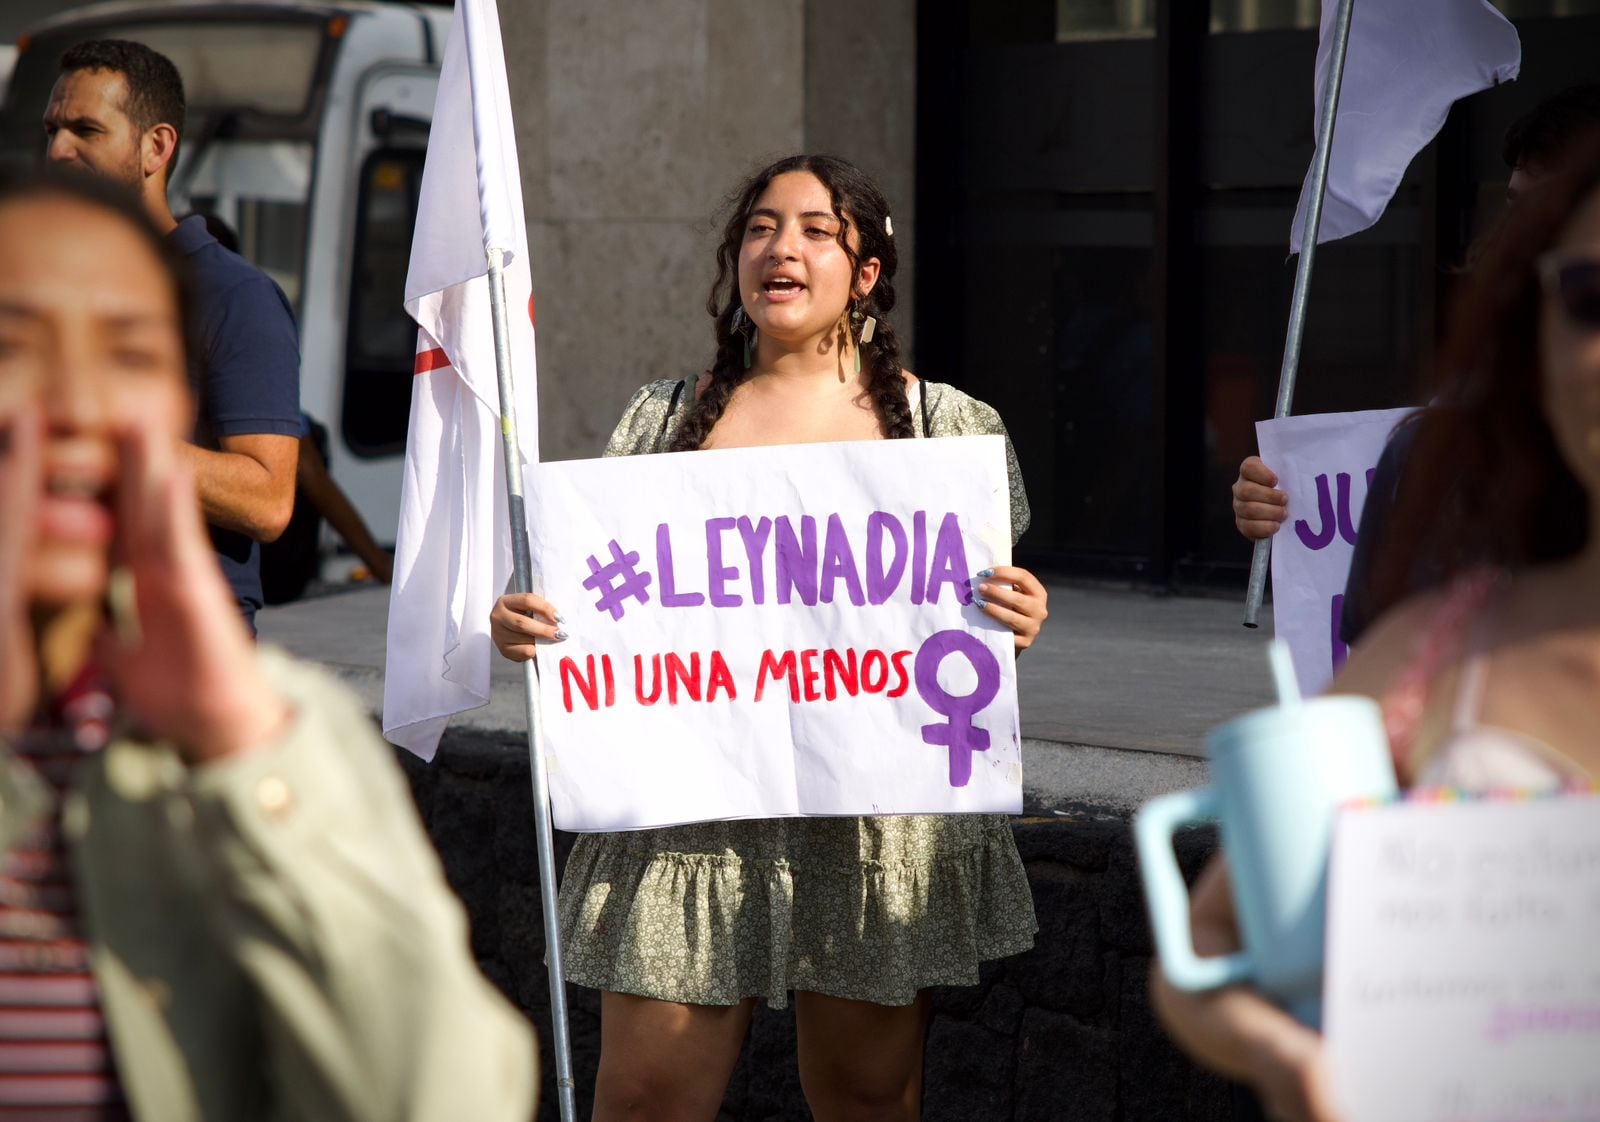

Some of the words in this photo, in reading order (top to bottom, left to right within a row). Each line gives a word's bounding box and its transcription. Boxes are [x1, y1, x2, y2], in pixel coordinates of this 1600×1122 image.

[582, 510, 972, 621] #LEYNADIA
[560, 653, 615, 713] NI
[634, 650, 737, 705] UNA
[754, 647, 913, 704] MENOS
